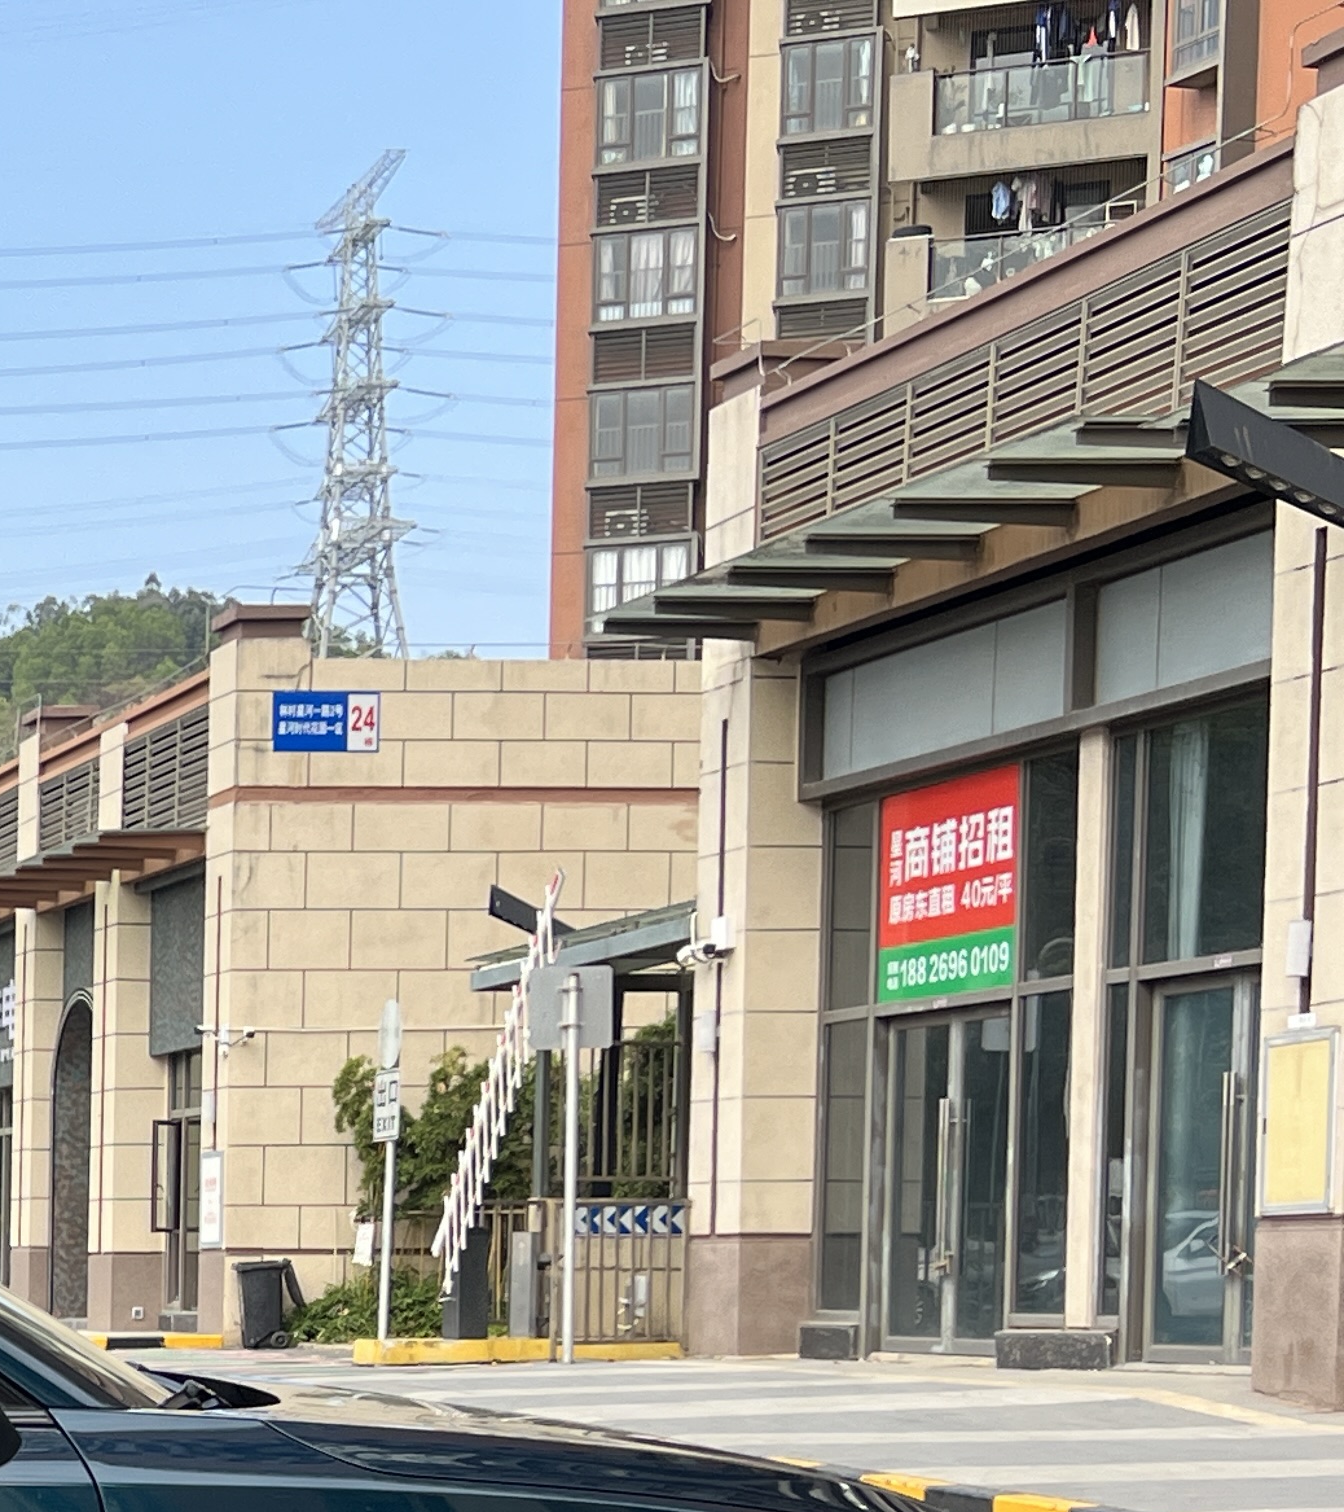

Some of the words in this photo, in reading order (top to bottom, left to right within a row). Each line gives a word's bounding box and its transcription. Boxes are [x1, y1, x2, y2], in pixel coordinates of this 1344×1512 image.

[351, 705, 376, 732] 24
[904, 805, 1014, 882] 商铺招租
[888, 883, 956, 925] 原房东直租
[960, 872, 1013, 911] 40元/平
[900, 956, 927, 988] 188
[928, 948, 968, 984] 2696
[970, 941, 1010, 977] 0109
[377, 1079, 398, 1107] 出口
[377, 1115, 396, 1133] EXIT
